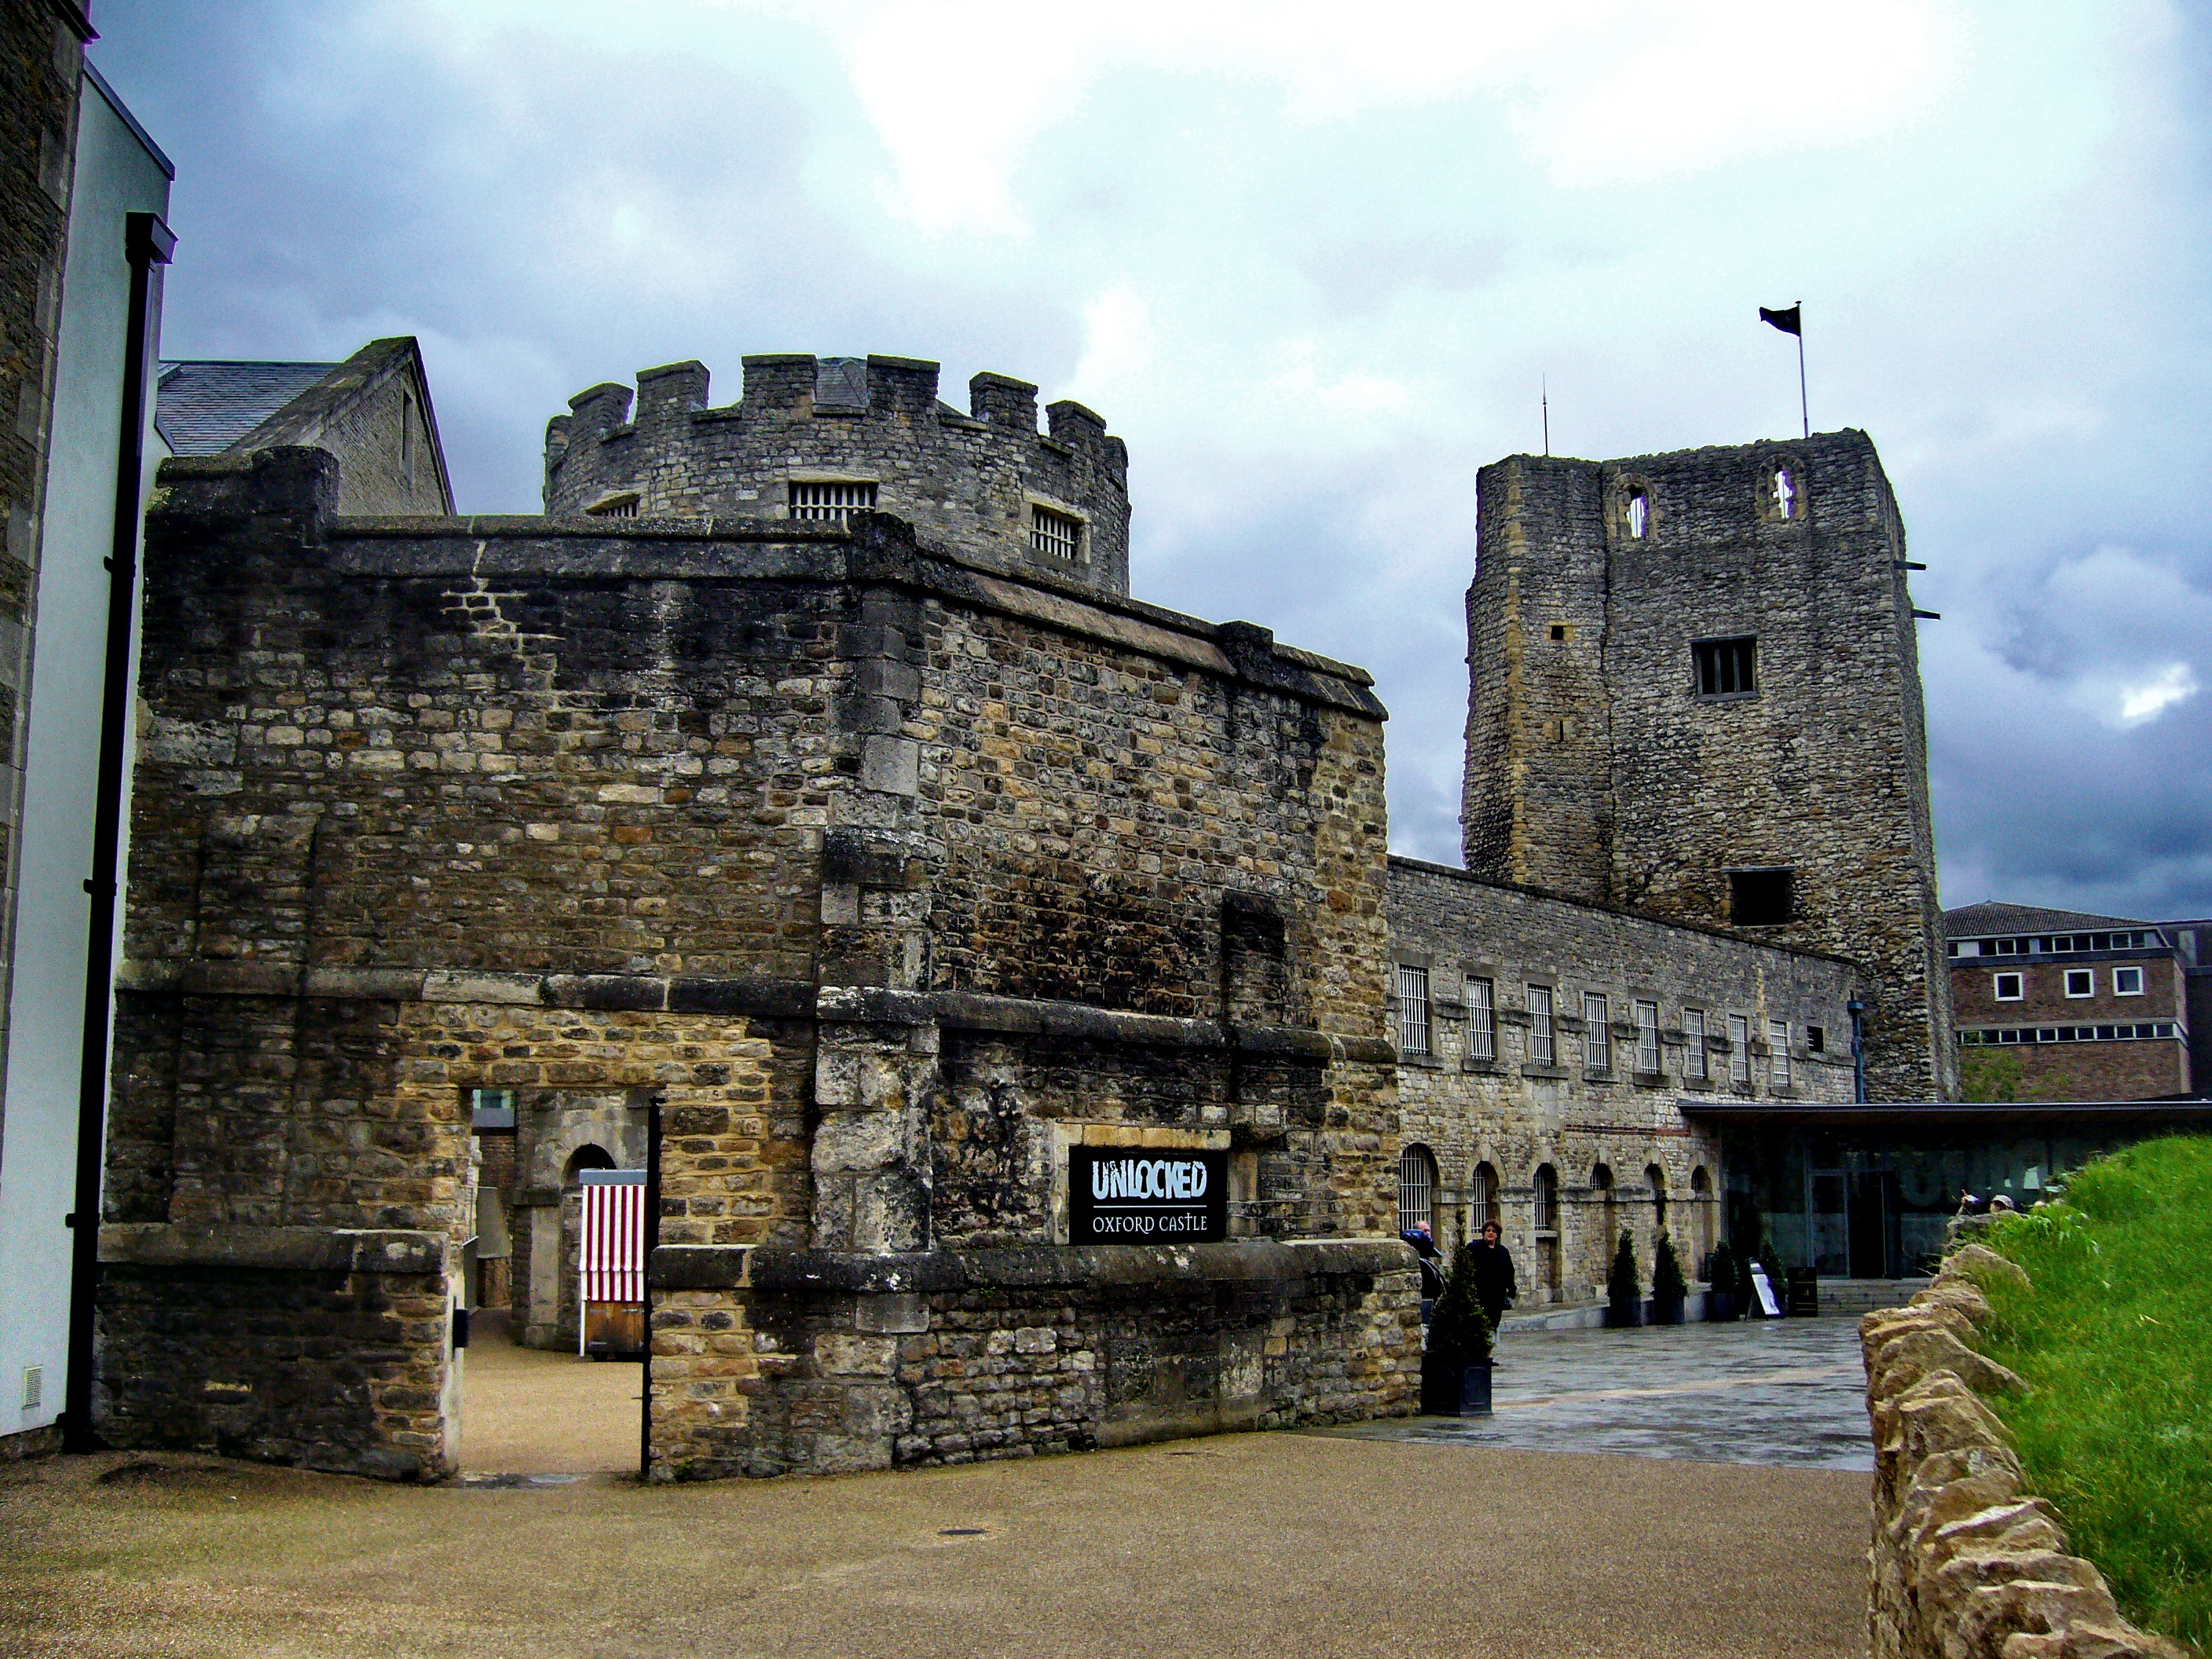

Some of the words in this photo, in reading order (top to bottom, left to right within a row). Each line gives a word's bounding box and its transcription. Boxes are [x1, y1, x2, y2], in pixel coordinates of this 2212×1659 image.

[1092, 1159, 1207, 1200] UNLOCKED
[1093, 1217, 1155, 1235] OXFORD
[1159, 1212, 1207, 1232] CASTLE
